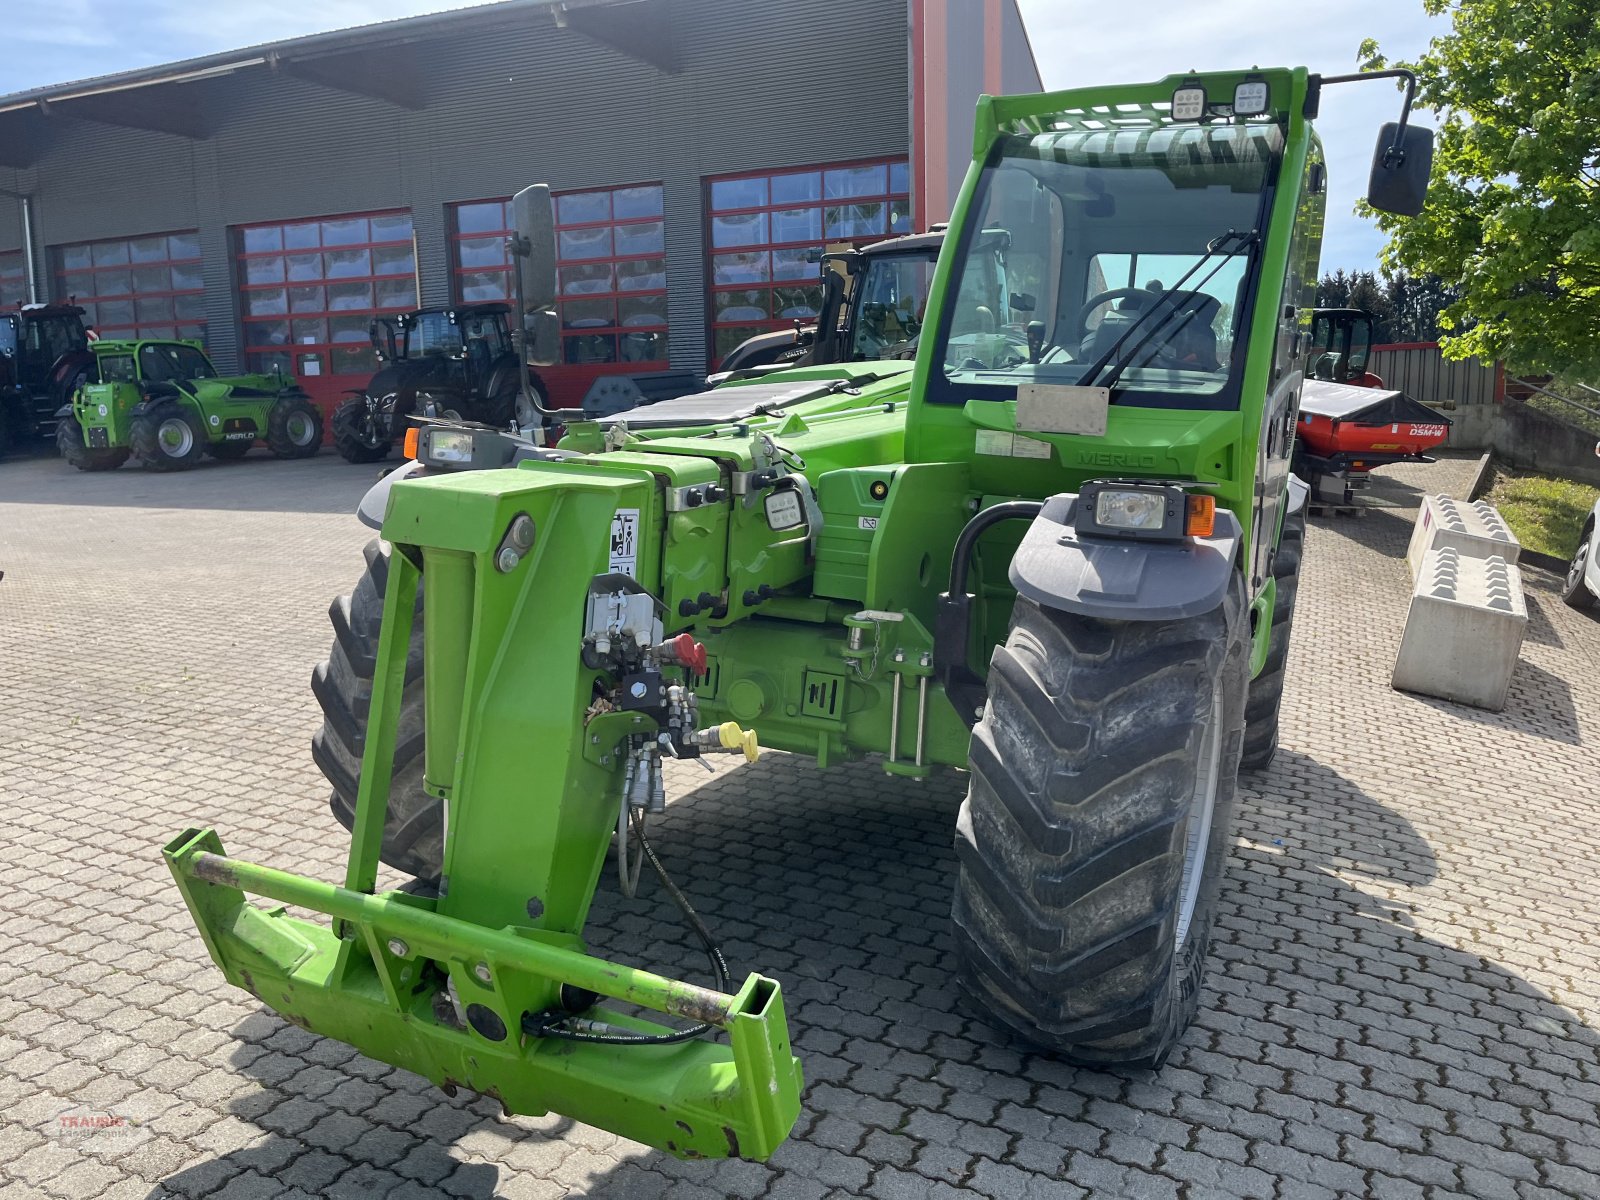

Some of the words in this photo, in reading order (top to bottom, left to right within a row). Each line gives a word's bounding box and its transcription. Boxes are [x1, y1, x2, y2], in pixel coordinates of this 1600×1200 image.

[225, 432, 255, 440] MERLO
[1409, 428, 1443, 437] DSM-W
[1078, 450, 1157, 469] MERLO
